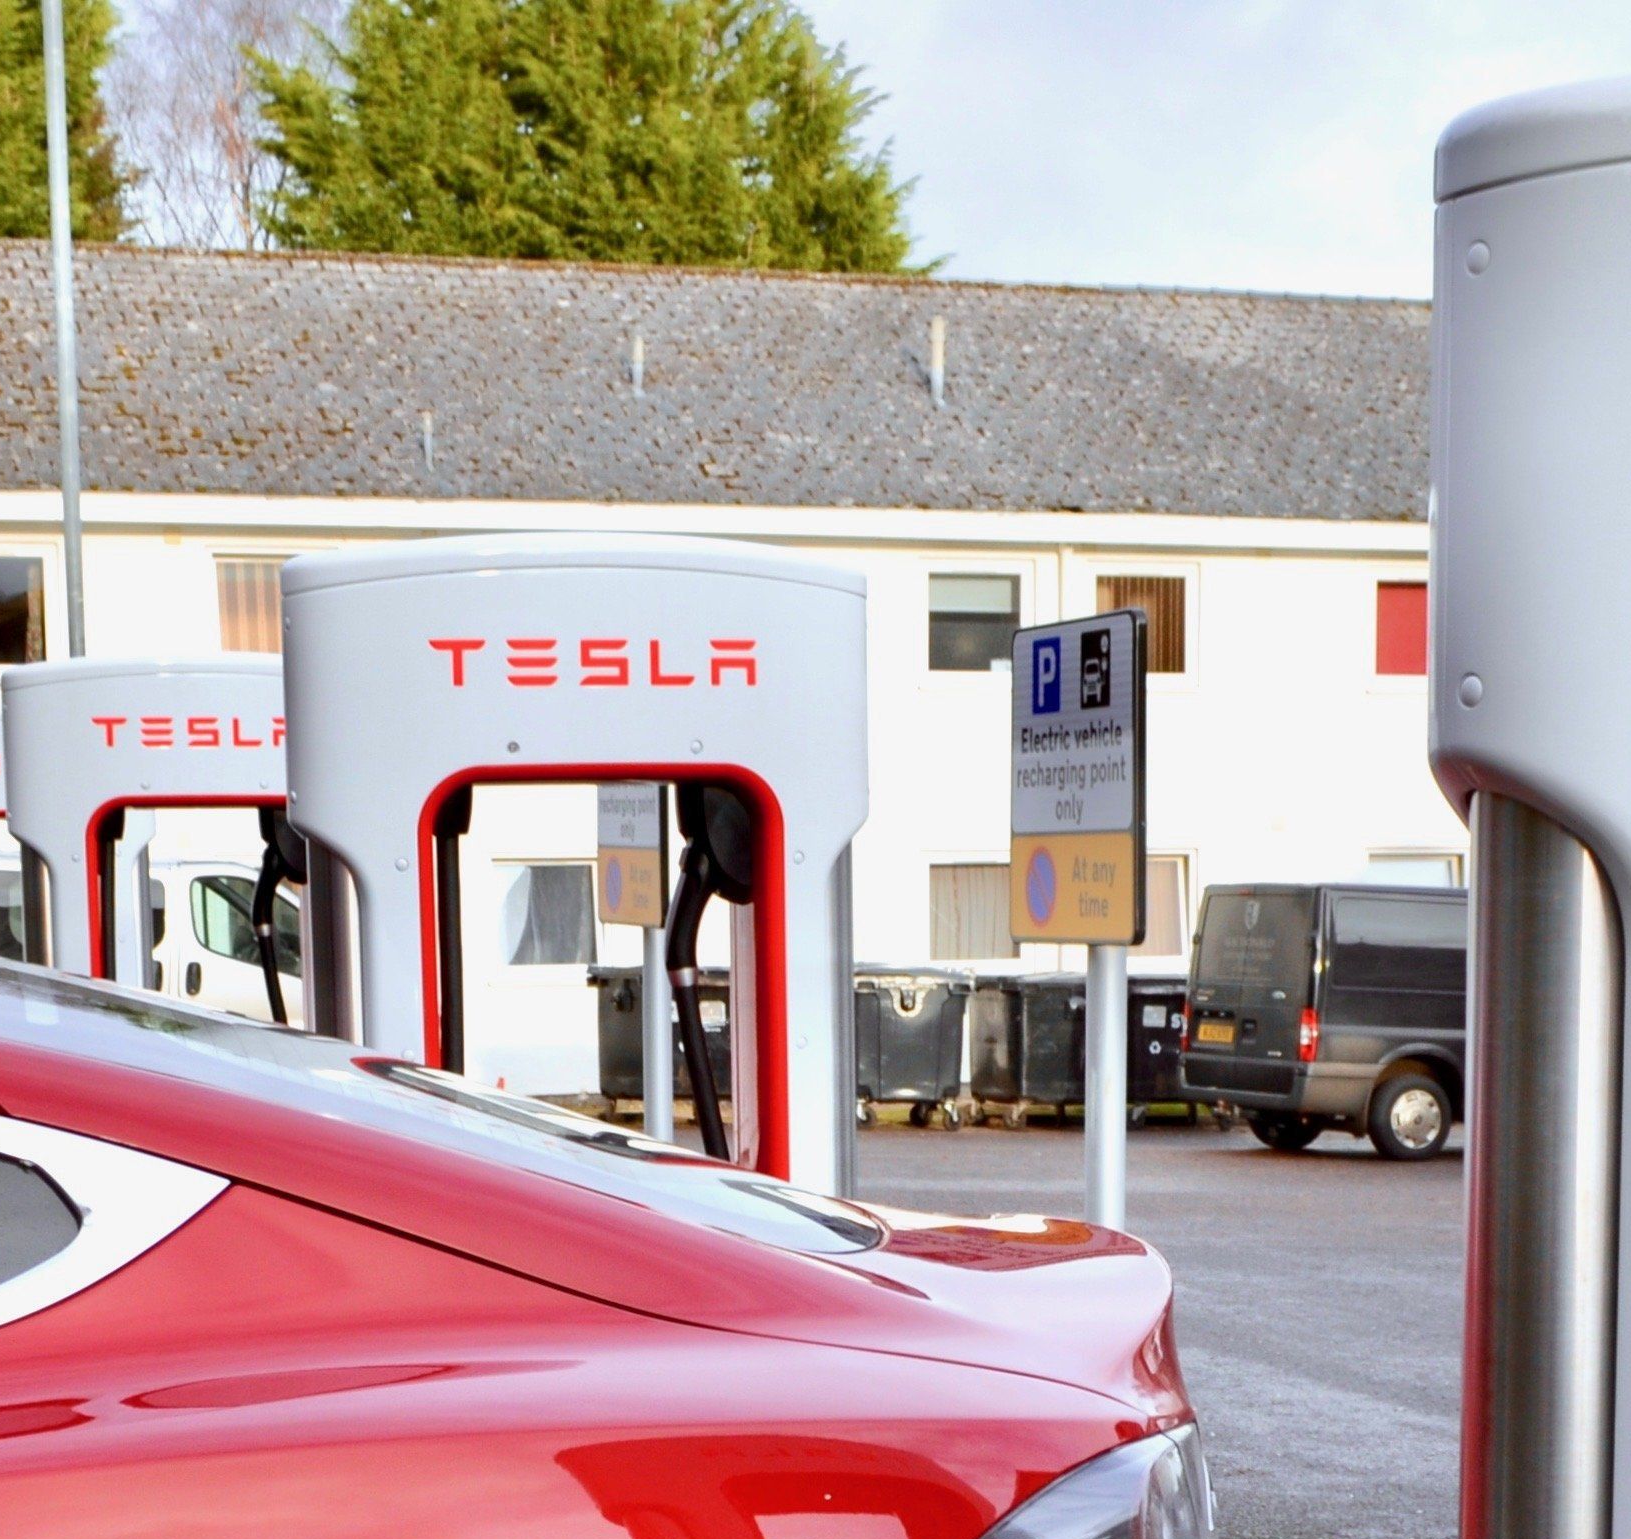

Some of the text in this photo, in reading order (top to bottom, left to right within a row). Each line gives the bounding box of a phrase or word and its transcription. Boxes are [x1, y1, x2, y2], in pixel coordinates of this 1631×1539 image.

[428, 639, 757, 686] TESLA
[1037, 646, 1057, 708] P
[1021, 719, 1123, 754] Electric vehicle
[1017, 755, 1126, 791] recharging point
[1055, 794, 1084, 825] only
[1072, 856, 1117, 888] At any
[1079, 892, 1109, 918] time
